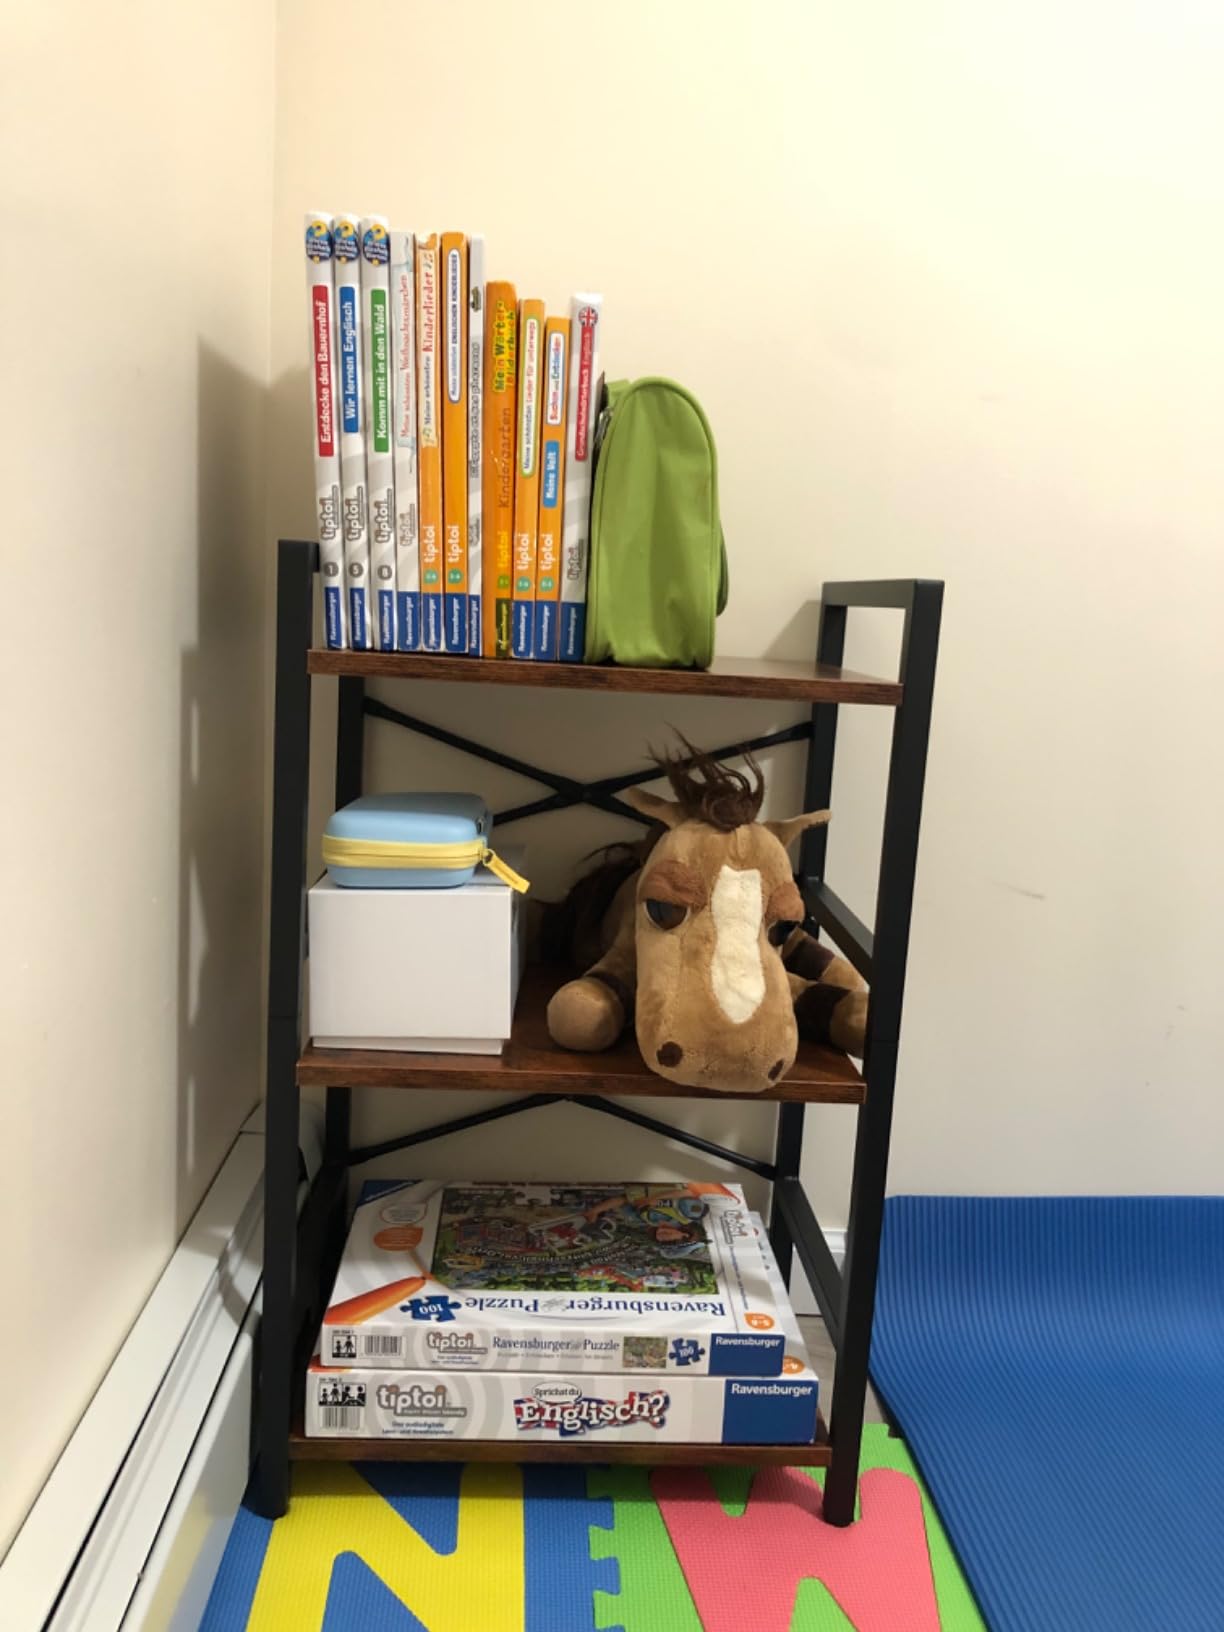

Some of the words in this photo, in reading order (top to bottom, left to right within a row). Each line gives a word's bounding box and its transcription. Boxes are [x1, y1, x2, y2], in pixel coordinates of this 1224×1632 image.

[343, 301, 357, 352] Englisch
[374, 304, 384, 335] Wald
[422, 271, 434, 352] Kinderlieder
[316, 300, 329, 362] Bauernhof
[374, 337, 384, 358] den
[318, 363, 330, 386] den
[345, 356, 355, 393] lernen
[375, 359, 385, 373] in
[424, 356, 432, 398] schönsten
[495, 359, 505, 391] Mein
[375, 374, 385, 398] mit
[319, 387, 332, 443] Entdecke
[344, 395, 356, 419] Wir
[375, 399, 387, 438] Komm
[424, 400, 432, 425] Meine
[499, 408, 512, 508] Kindergarten
[546, 473, 556, 499] Meine
[320, 497, 336, 540] tiptoi
[344, 498, 360, 541] tiptoi
[375, 500, 389, 543] tiptoi
[424, 525, 439, 562] tiptoi
[448, 525, 463, 562] tiptoi
[497, 531, 510, 568] tiptoi
[517, 533, 532, 570] tiptoi
[540, 534, 556, 570] tiptoi
[452, 598, 460, 645] Ravensburger
[471, 600, 479, 649] Ravensburger
[419, 1303, 443, 1314] 100
[465, 1296, 539, 1313] Puzzle
[565, 1296, 726, 1317] Ravensburger
[427, 1331, 474, 1351] tiptoi
[493, 1335, 572, 1351] Ravensburger
[583, 1338, 620, 1351] Puzzle
[679, 1347, 695, 1358] 100
[715, 1336, 781, 1348] Ravensburger
[377, 1385, 447, 1415] tiptoi
[534, 1387, 567, 1397] Sprichst
[568, 1386, 579, 1396] du
[731, 1383, 813, 1397] Ravensburger
[520, 1393, 666, 1431] Englisch?
